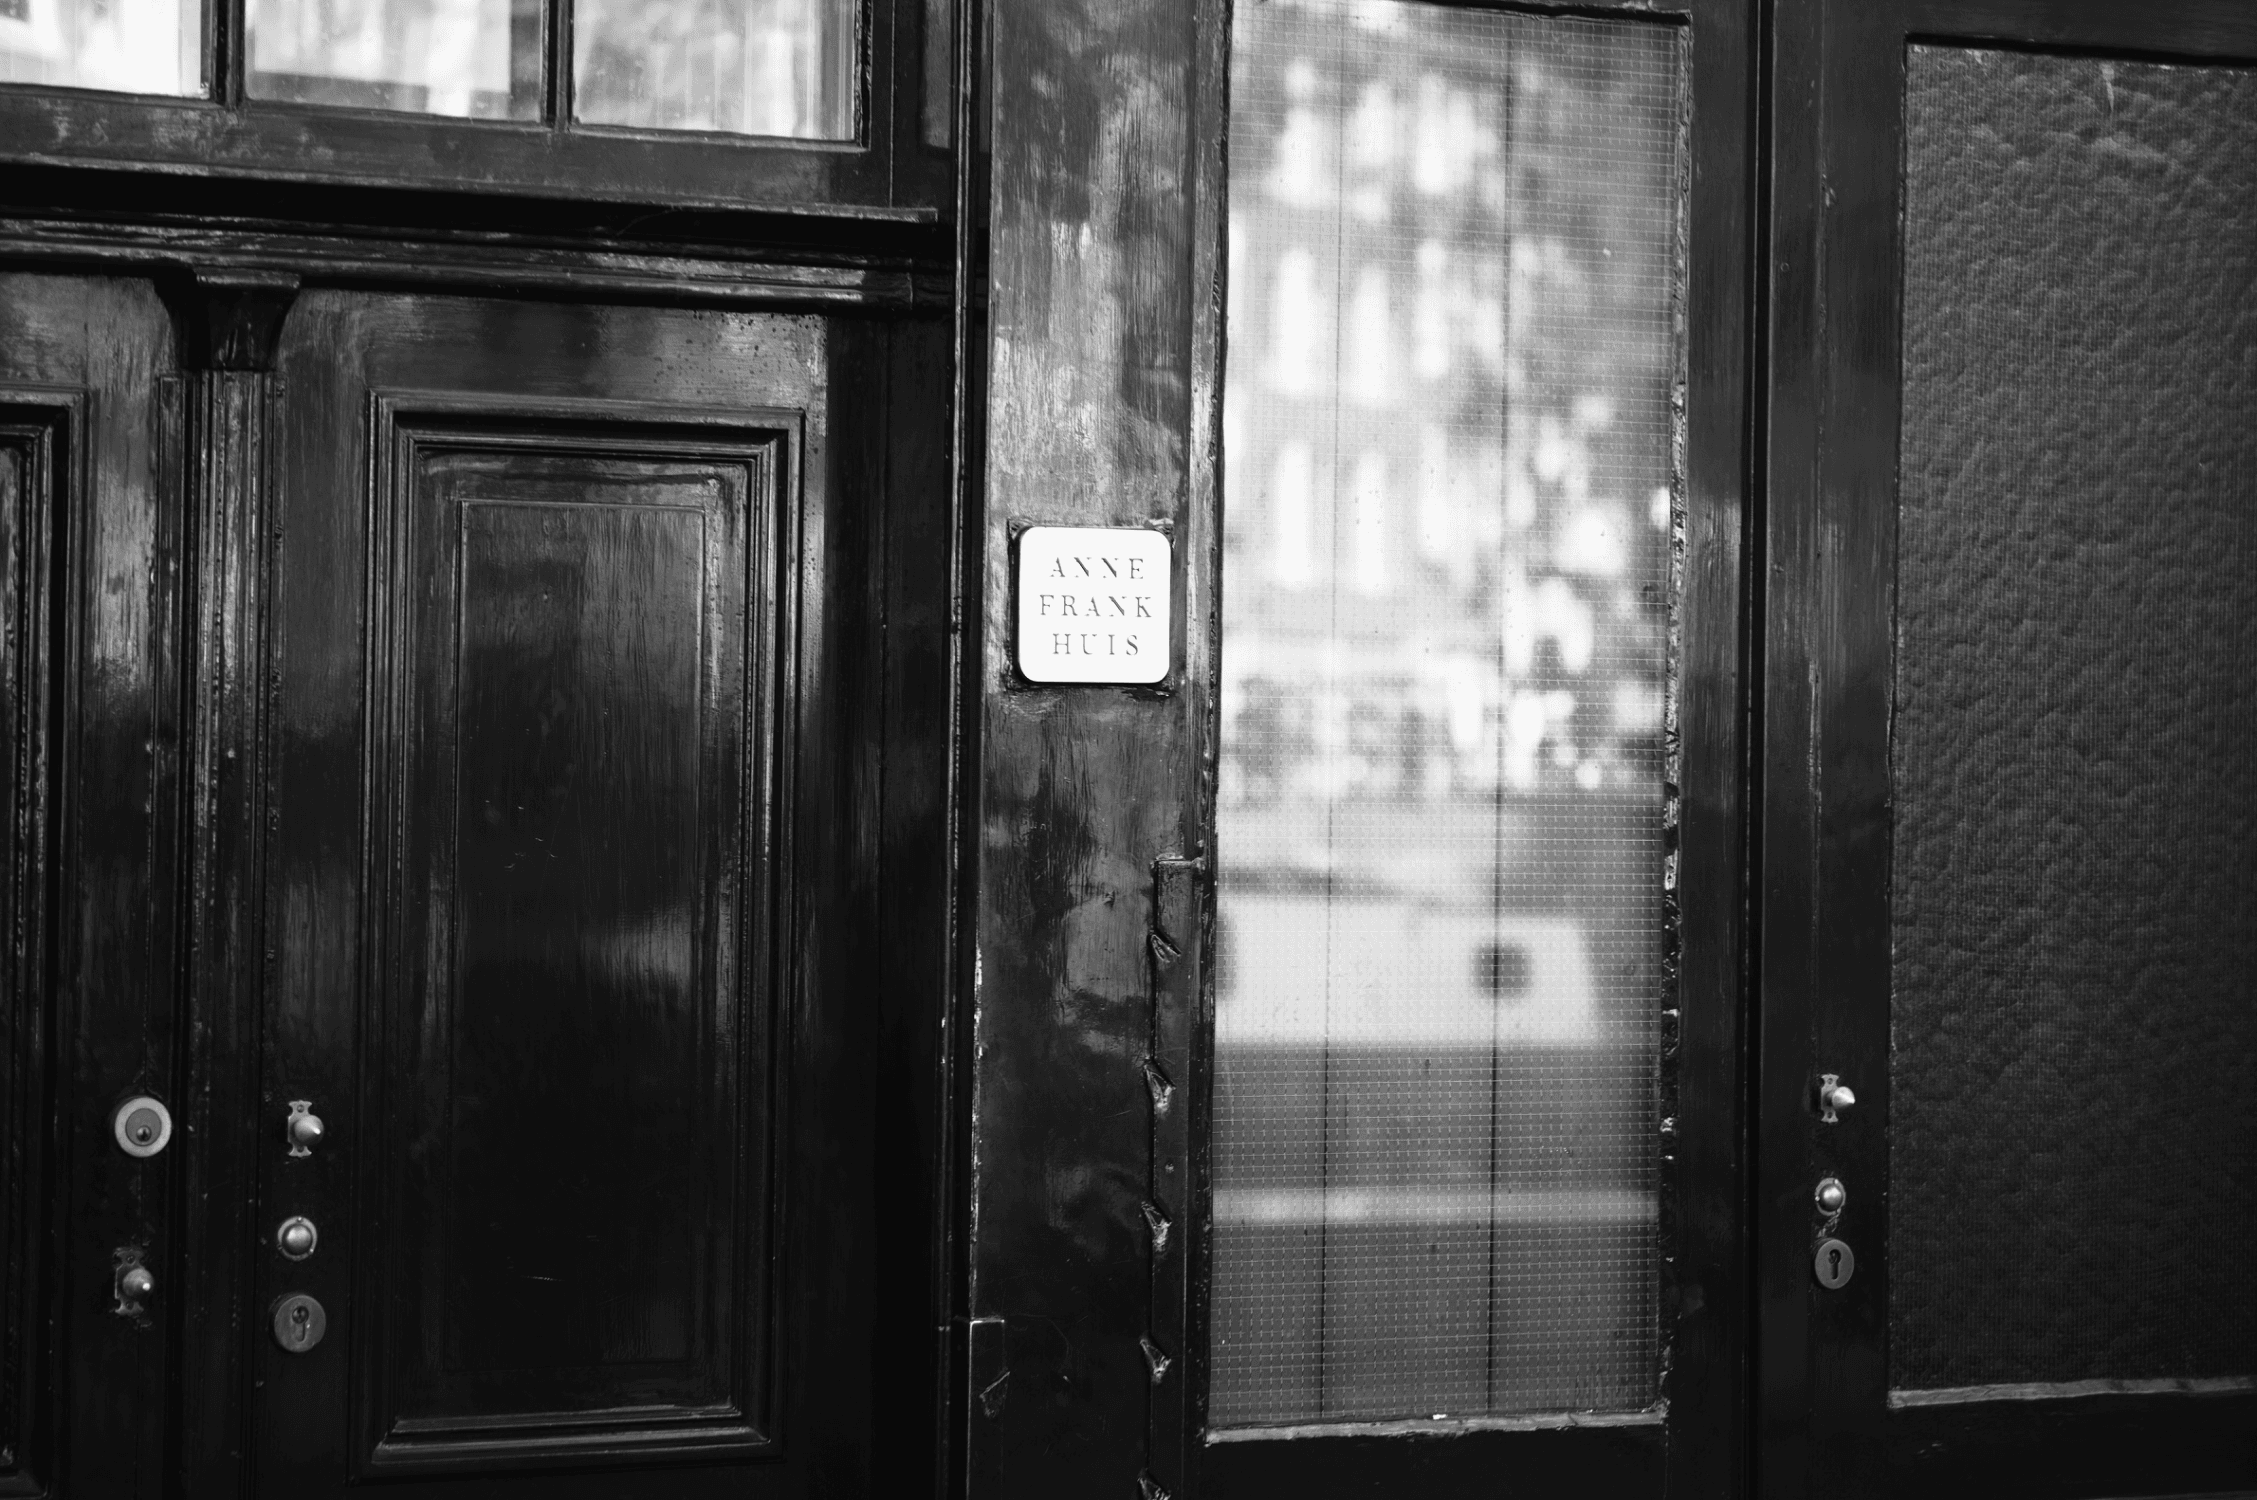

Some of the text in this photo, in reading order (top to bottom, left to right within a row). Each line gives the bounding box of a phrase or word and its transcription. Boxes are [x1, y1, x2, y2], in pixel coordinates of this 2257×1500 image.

[1050, 557, 1143, 579] ANNE
[1040, 594, 1152, 618] FRANK
[1053, 633, 1139, 656] HUIS
